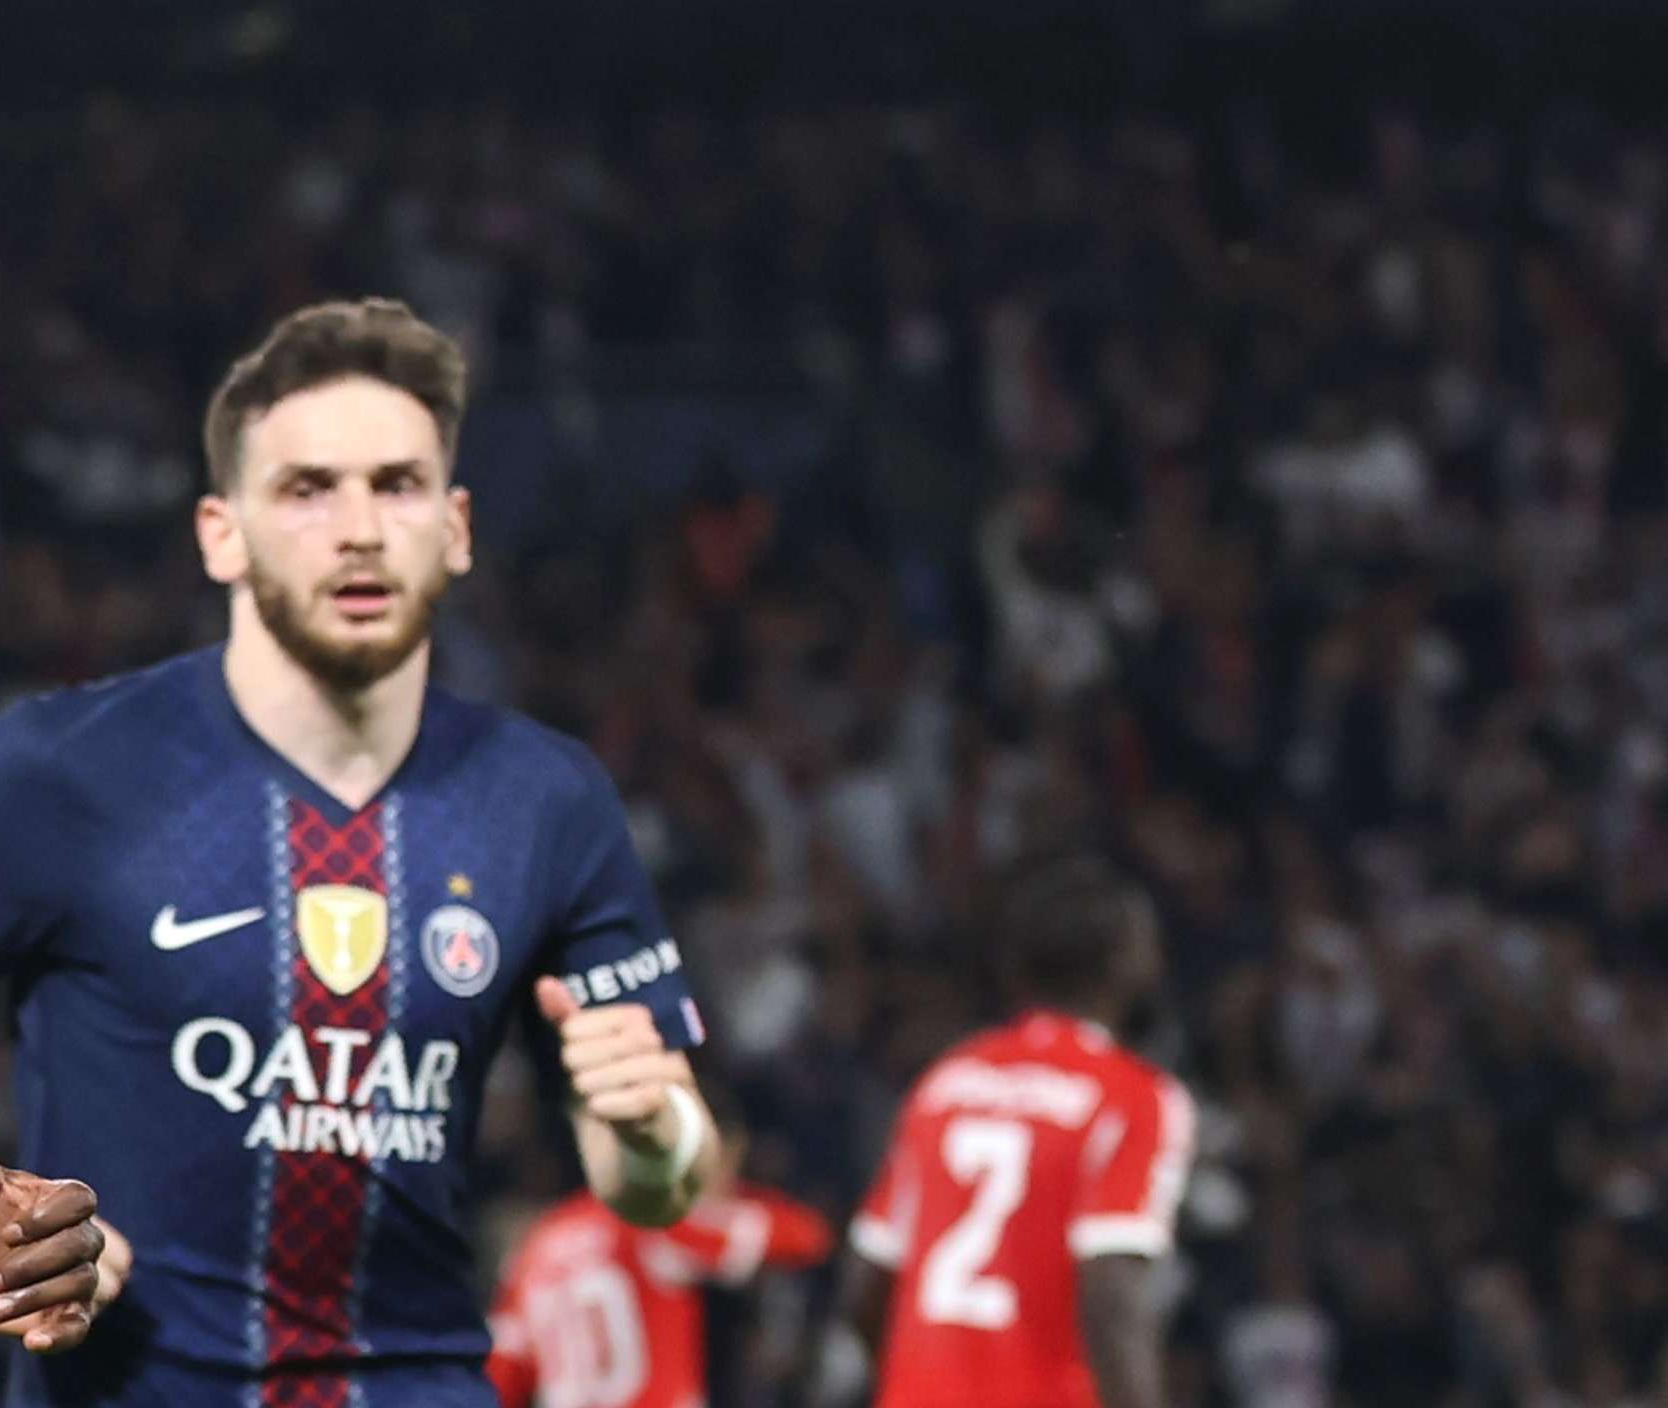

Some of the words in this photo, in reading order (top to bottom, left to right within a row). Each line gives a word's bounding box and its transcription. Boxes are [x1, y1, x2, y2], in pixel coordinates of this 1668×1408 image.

[172, 1016, 459, 1113] QATAR
[244, 1102, 447, 1163] AIRWAYS
[917, 1116, 1032, 1330] 2
